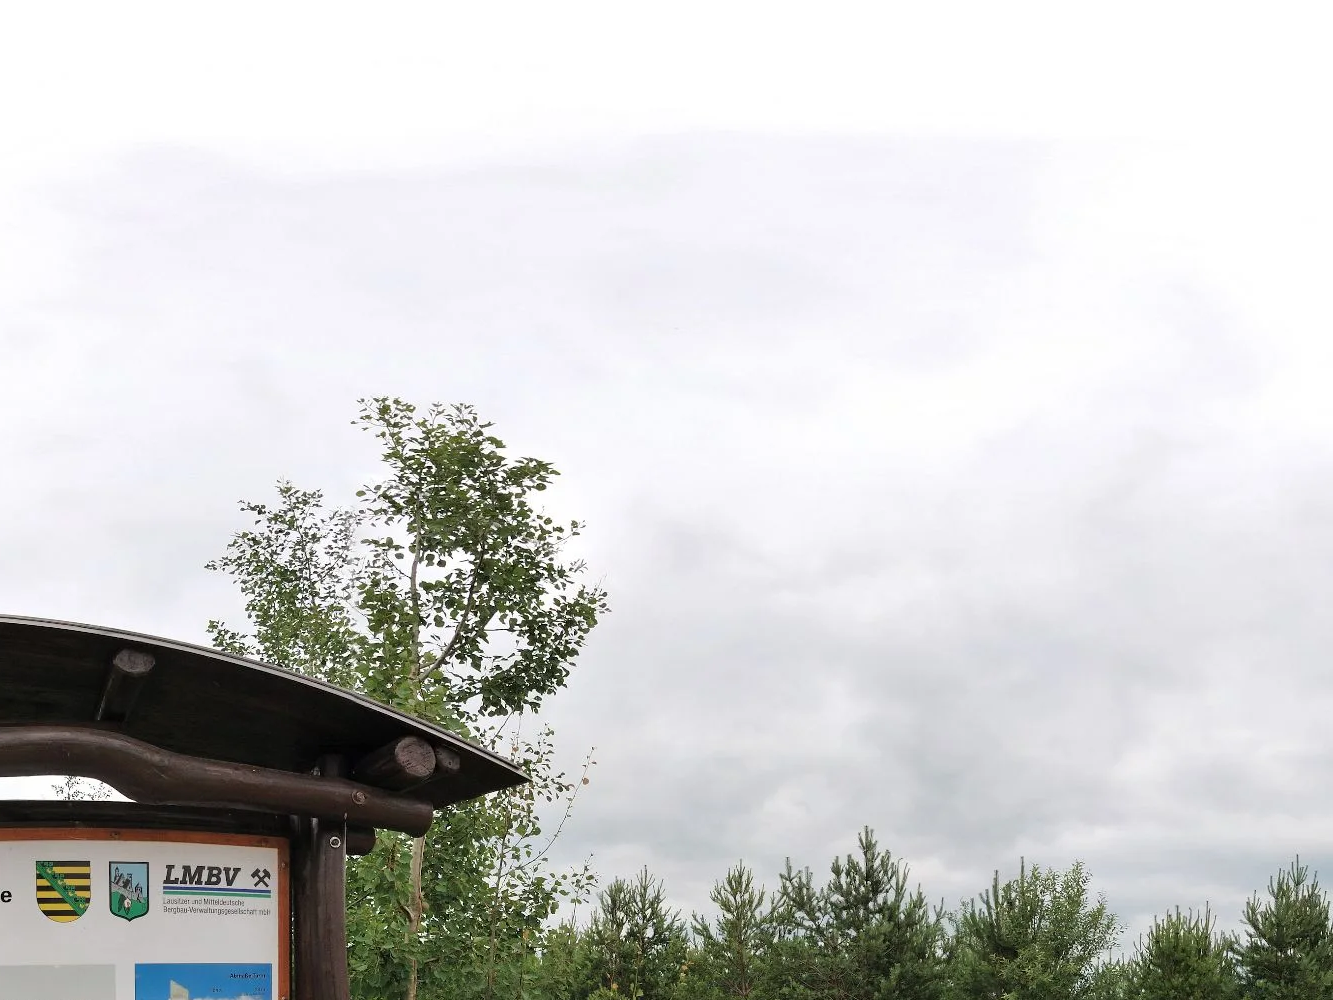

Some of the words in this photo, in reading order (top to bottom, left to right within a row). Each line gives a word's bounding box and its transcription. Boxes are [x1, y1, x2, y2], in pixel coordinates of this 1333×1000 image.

[163, 864, 241, 886] LMBV
[203, 898, 245, 906] Mitteldeutsche
[163, 906, 257, 916] Bergbau-Verwaltungsgesellschaft
